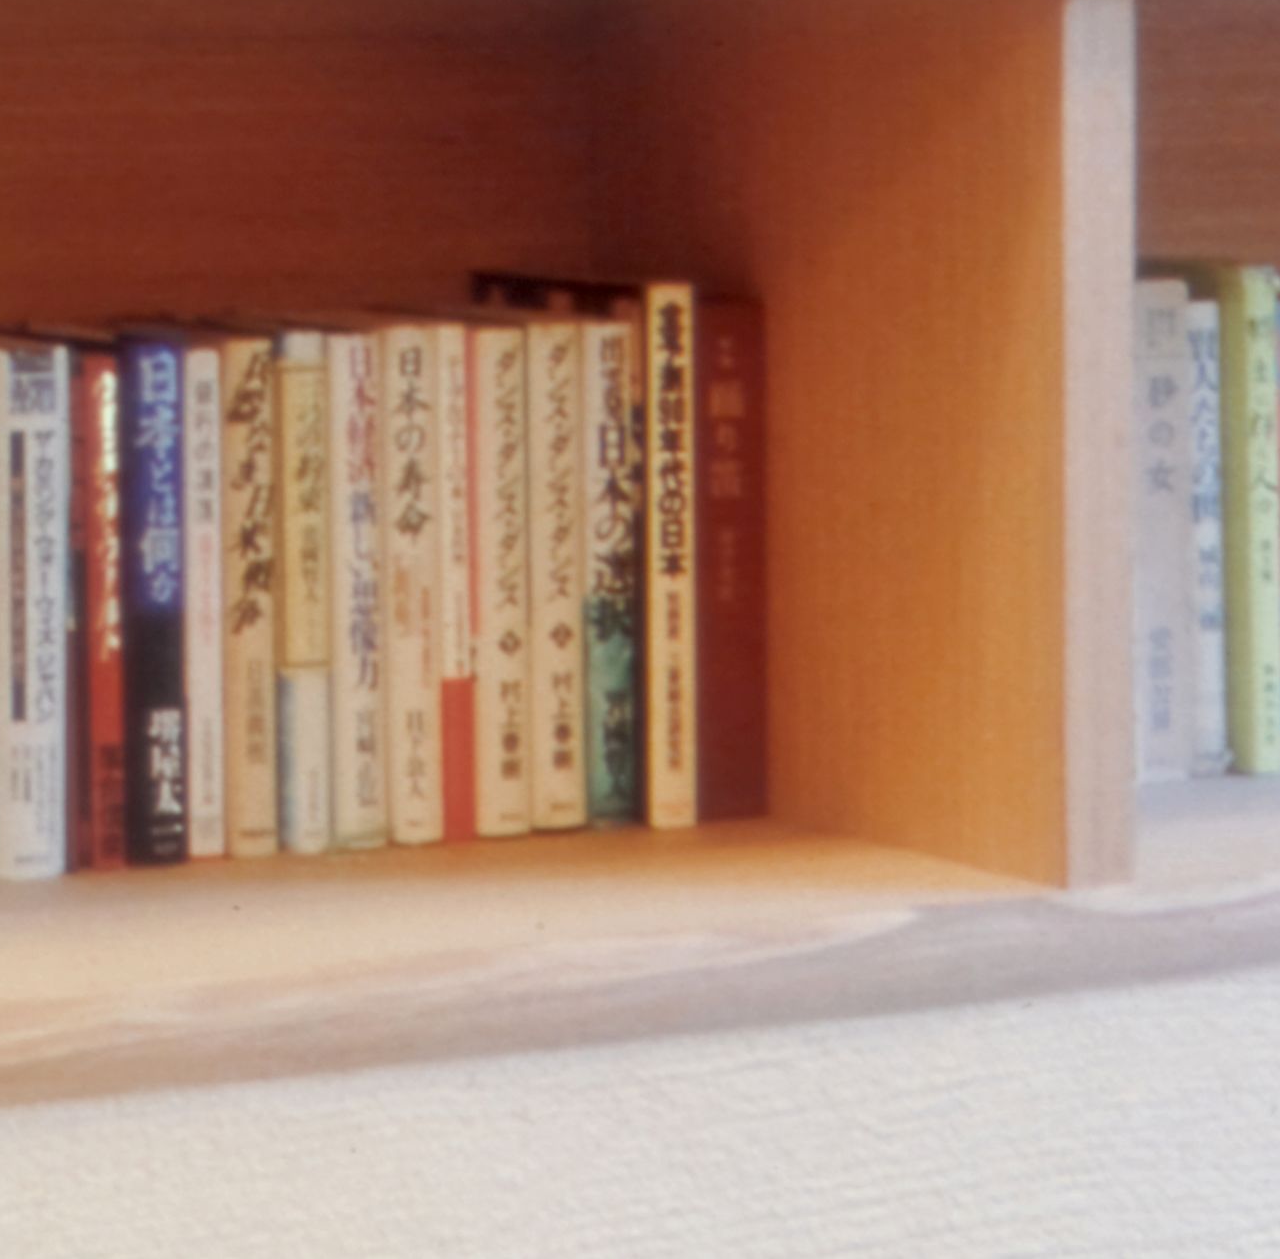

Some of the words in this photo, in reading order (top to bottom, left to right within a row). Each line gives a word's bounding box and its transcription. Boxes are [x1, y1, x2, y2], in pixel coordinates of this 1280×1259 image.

[138, 350, 182, 605] 日本とは何か
[393, 347, 433, 542] 日本の寿命
